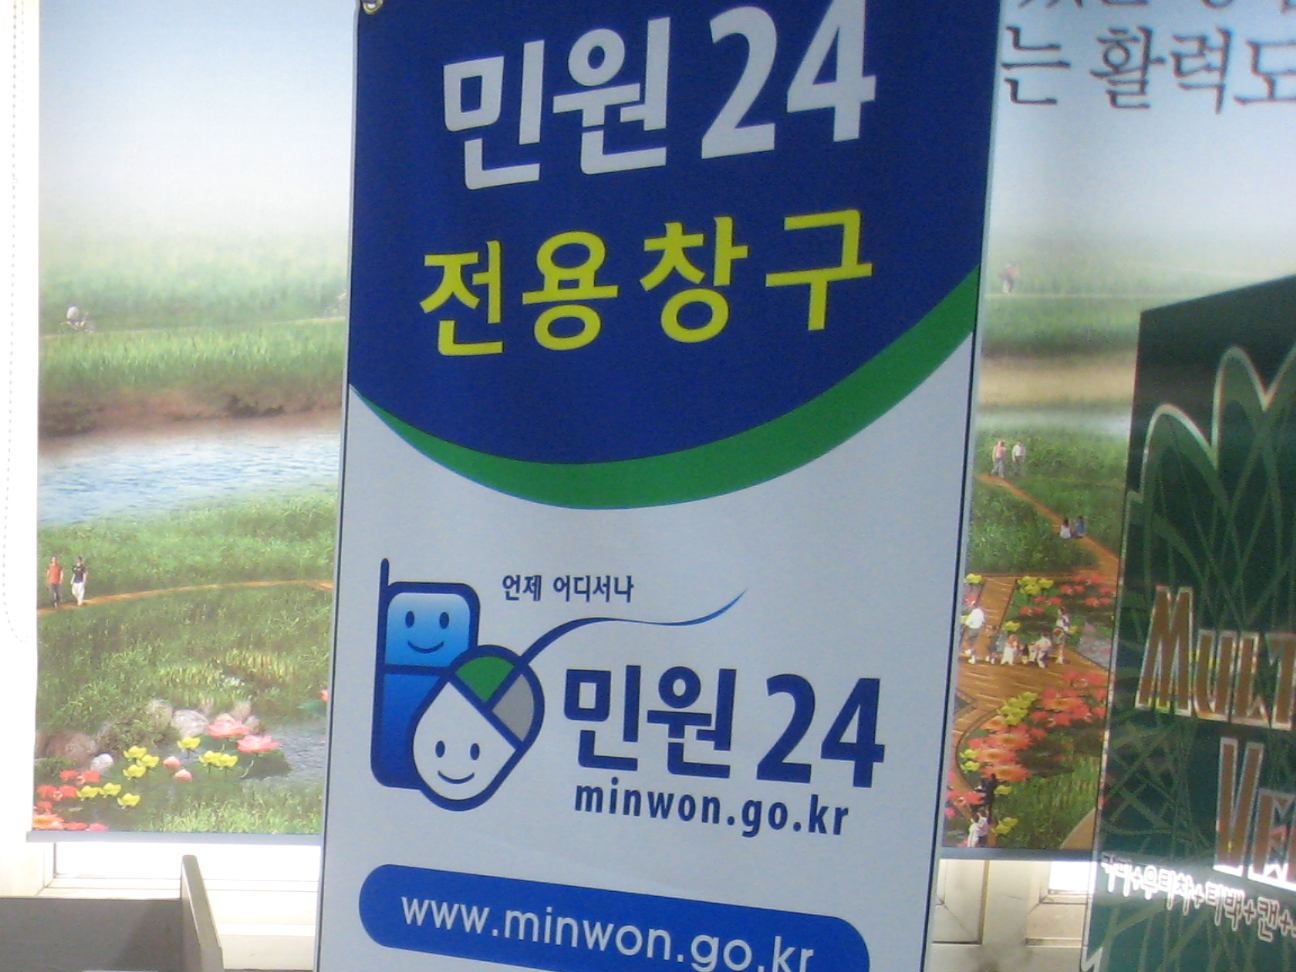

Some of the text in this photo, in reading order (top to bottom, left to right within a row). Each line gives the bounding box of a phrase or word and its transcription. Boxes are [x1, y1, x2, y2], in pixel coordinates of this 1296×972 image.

[442, 0, 878, 190] 민원24
[1001, 26, 1071, 105] 는
[419, 209, 874, 356] 전용창구
[502, 575, 635, 604] 언제 어디서나
[563, 665, 885, 788] 민원24
[574, 777, 850, 838] minwon.go.kr
